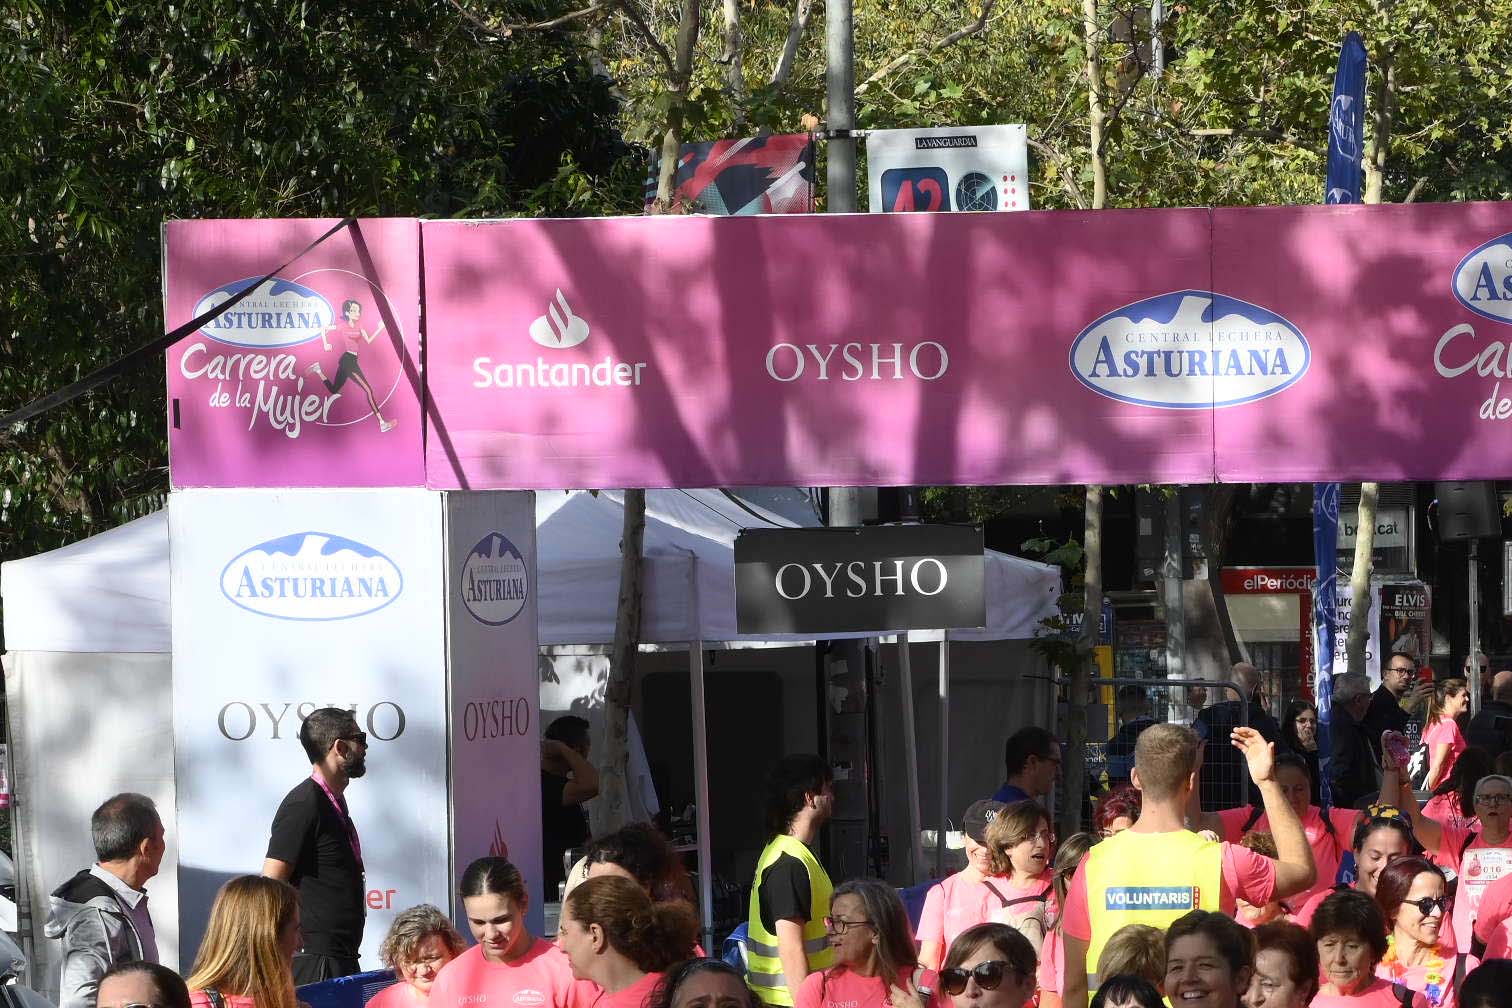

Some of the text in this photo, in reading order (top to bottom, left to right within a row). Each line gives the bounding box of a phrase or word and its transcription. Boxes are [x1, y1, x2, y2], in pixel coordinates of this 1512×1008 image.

[1125, 332, 1199, 343] CENTRAL
[180, 344, 297, 381] Carrera
[473, 357, 647, 388] Santander
[765, 341, 948, 383] OYSHO
[1089, 338, 1291, 378] ASTURIANA
[210, 378, 342, 438] de la Mujer
[1480, 381, 1512, 420] de
[235, 565, 389, 598] ASTURIANA
[467, 568, 525, 602] ASTURIANA
[775, 558, 948, 601] OYSHO
[1395, 594, 1425, 607] ELVIS
[464, 697, 530, 742] OYSHO
[1107, 892, 1190, 905] VOLUNTARIS
